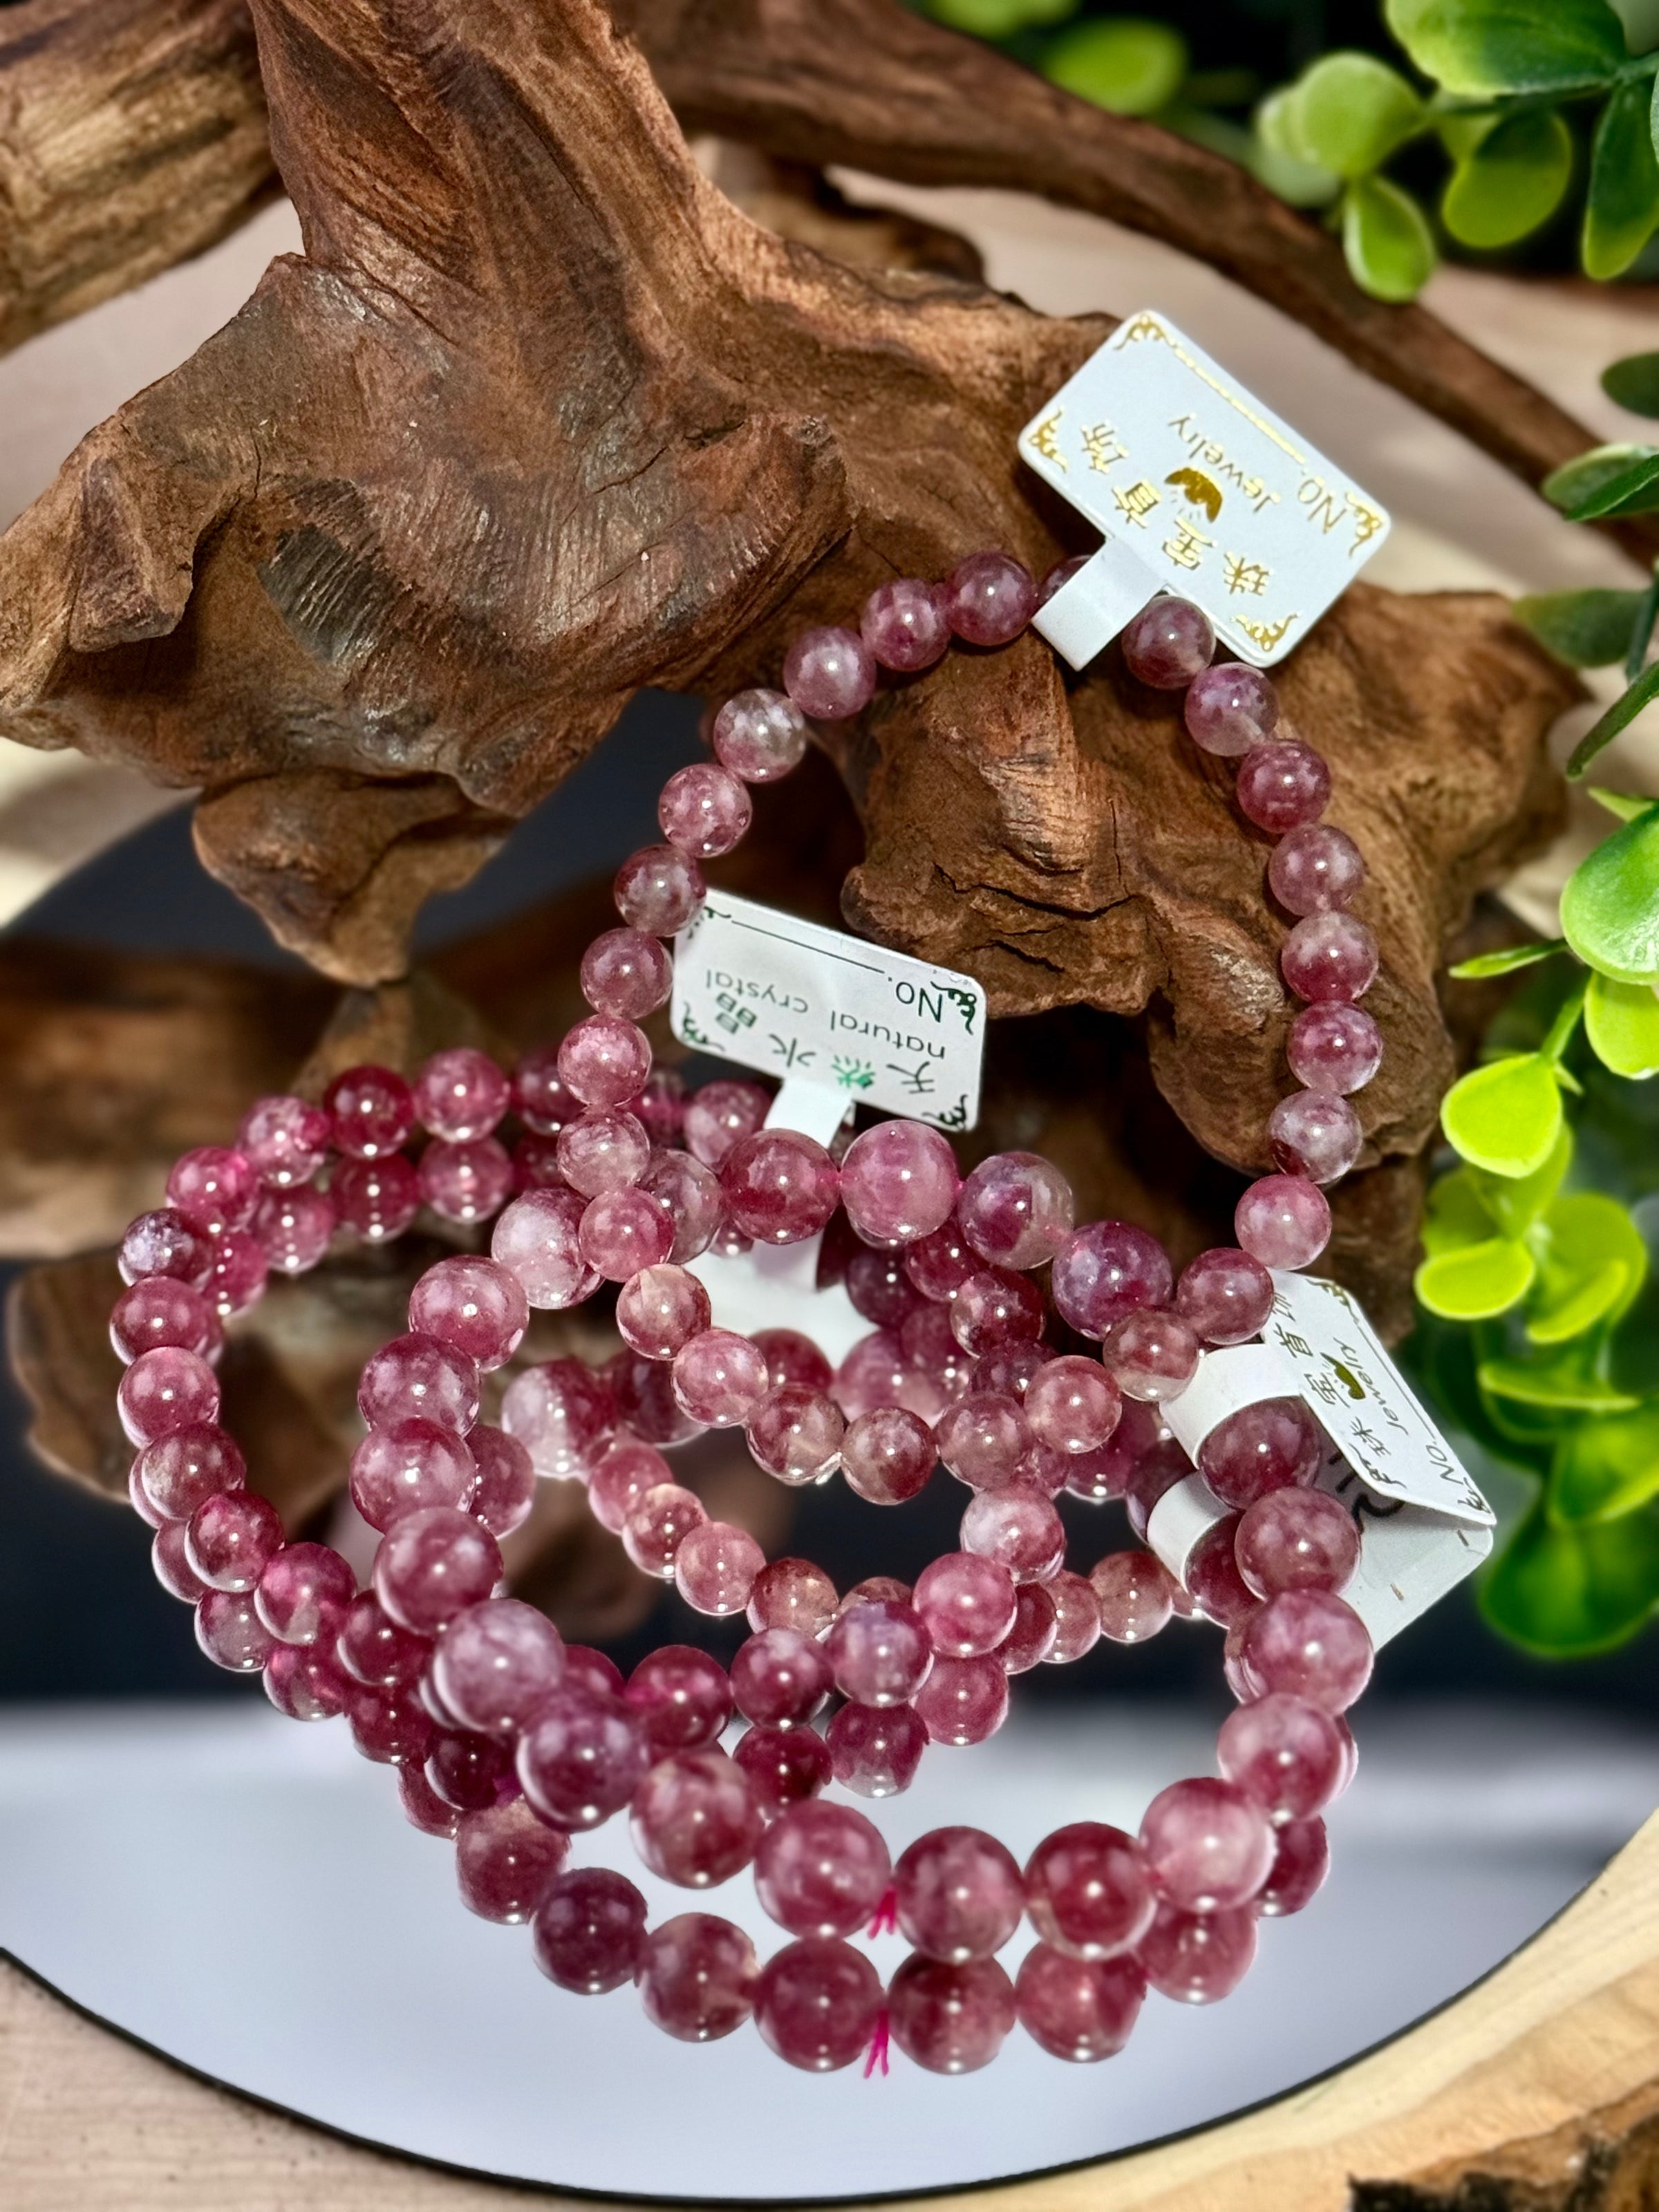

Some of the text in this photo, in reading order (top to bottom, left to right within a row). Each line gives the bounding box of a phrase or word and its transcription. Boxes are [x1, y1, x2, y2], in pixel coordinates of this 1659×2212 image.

[1080, 422, 1273, 597] 珠宝首饰
[1168, 413, 1282, 514] Jewelry
[706, 969, 947, 1059] natural crystal
[715, 992, 935, 1095] 天然水晶
[888, 977, 944, 1023] No.
[1333, 1337, 1409, 1436] Jewelry
